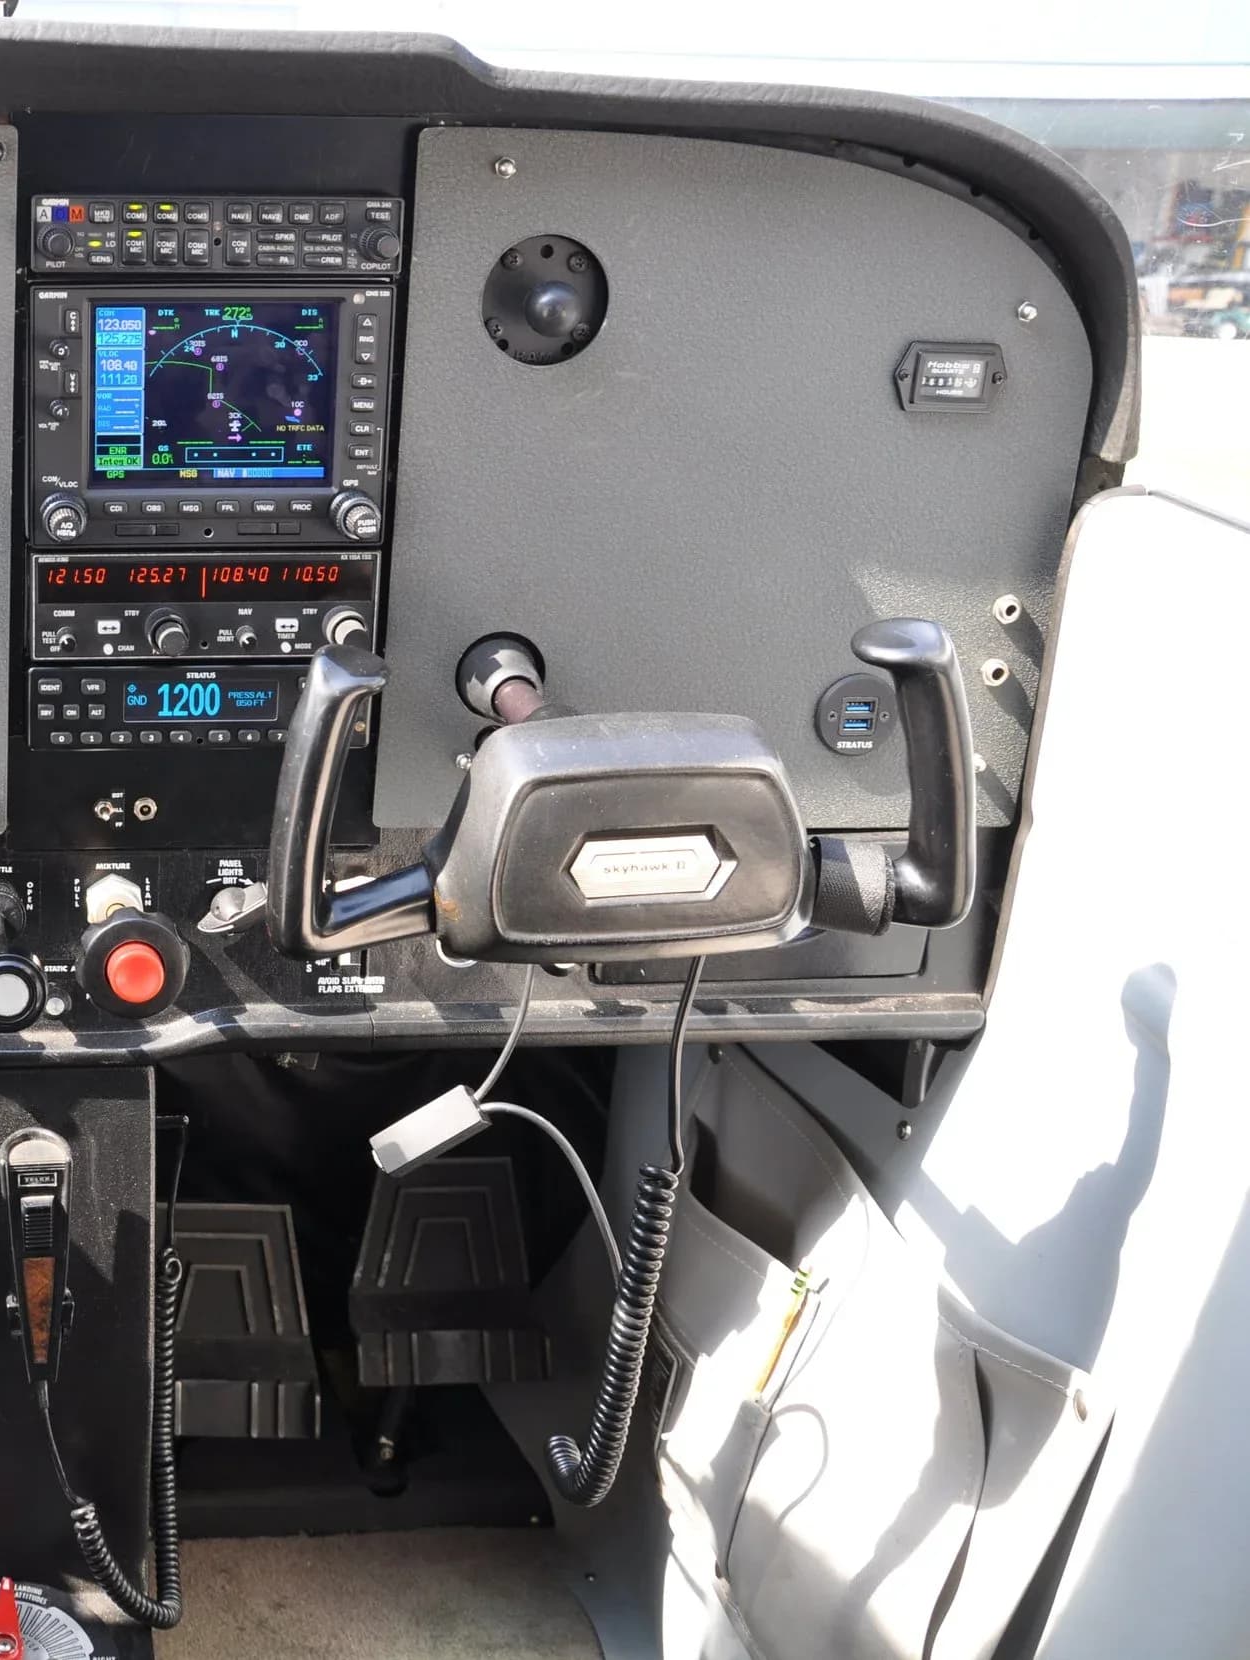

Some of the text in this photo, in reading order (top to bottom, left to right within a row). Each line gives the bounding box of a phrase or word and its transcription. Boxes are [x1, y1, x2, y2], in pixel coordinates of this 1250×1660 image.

[294, 213, 310, 221] DME
[325, 213, 340, 221] ADF
[275, 233, 295, 241] SPKR
[91, 255, 111, 263] SENS
[98, 319, 142, 331] 123.050
[101, 359, 137, 371] 108.40
[927, 360, 970, 369] Hobbs
[101, 374, 137, 385] 111.20
[354, 401, 374, 409] MENU
[355, 425, 370, 433] CLR
[109, 447, 127, 455] ENR
[354, 449, 369, 457] ENT
[126, 457, 138, 465] OK
[106, 470, 125, 479] GPS
[342, 479, 358, 487] GPS
[109, 505, 123, 513] CDI
[146, 504, 161, 512] OBS
[182, 504, 199, 512] MSG
[221, 503, 234, 511] FPL
[256, 503, 274, 511] VNAV
[292, 503, 312, 511] PROC
[357, 519, 376, 527] PUSH
[48, 566, 186, 584] 121.50 125.27
[212, 565, 339, 583] 108.40 110.50
[238, 608, 253, 616] NAV
[277, 632, 295, 640] TIMER
[40, 684, 61, 692] IDENT
[228, 691, 274, 699] PRESS ALT
[127, 695, 147, 706] GND
[157, 682, 221, 717] 1200
[253, 699, 264, 707] FT
[837, 741, 873, 749] STRATUS
[95, 862, 131, 870] MIXTURE
[219, 860, 242, 868] PANEL
[603, 861, 686, 874] skyhawk II
[218, 868, 243, 876] LIGHTS
[26, 881, 34, 911] OPEN
[318, 977, 340, 985] AVOID
[318, 985, 384, 993] FLAPS EXTENDED
[14, 1584, 44, 1594] LANDING
[14, 1591, 48, 1605] ATTITUDES
